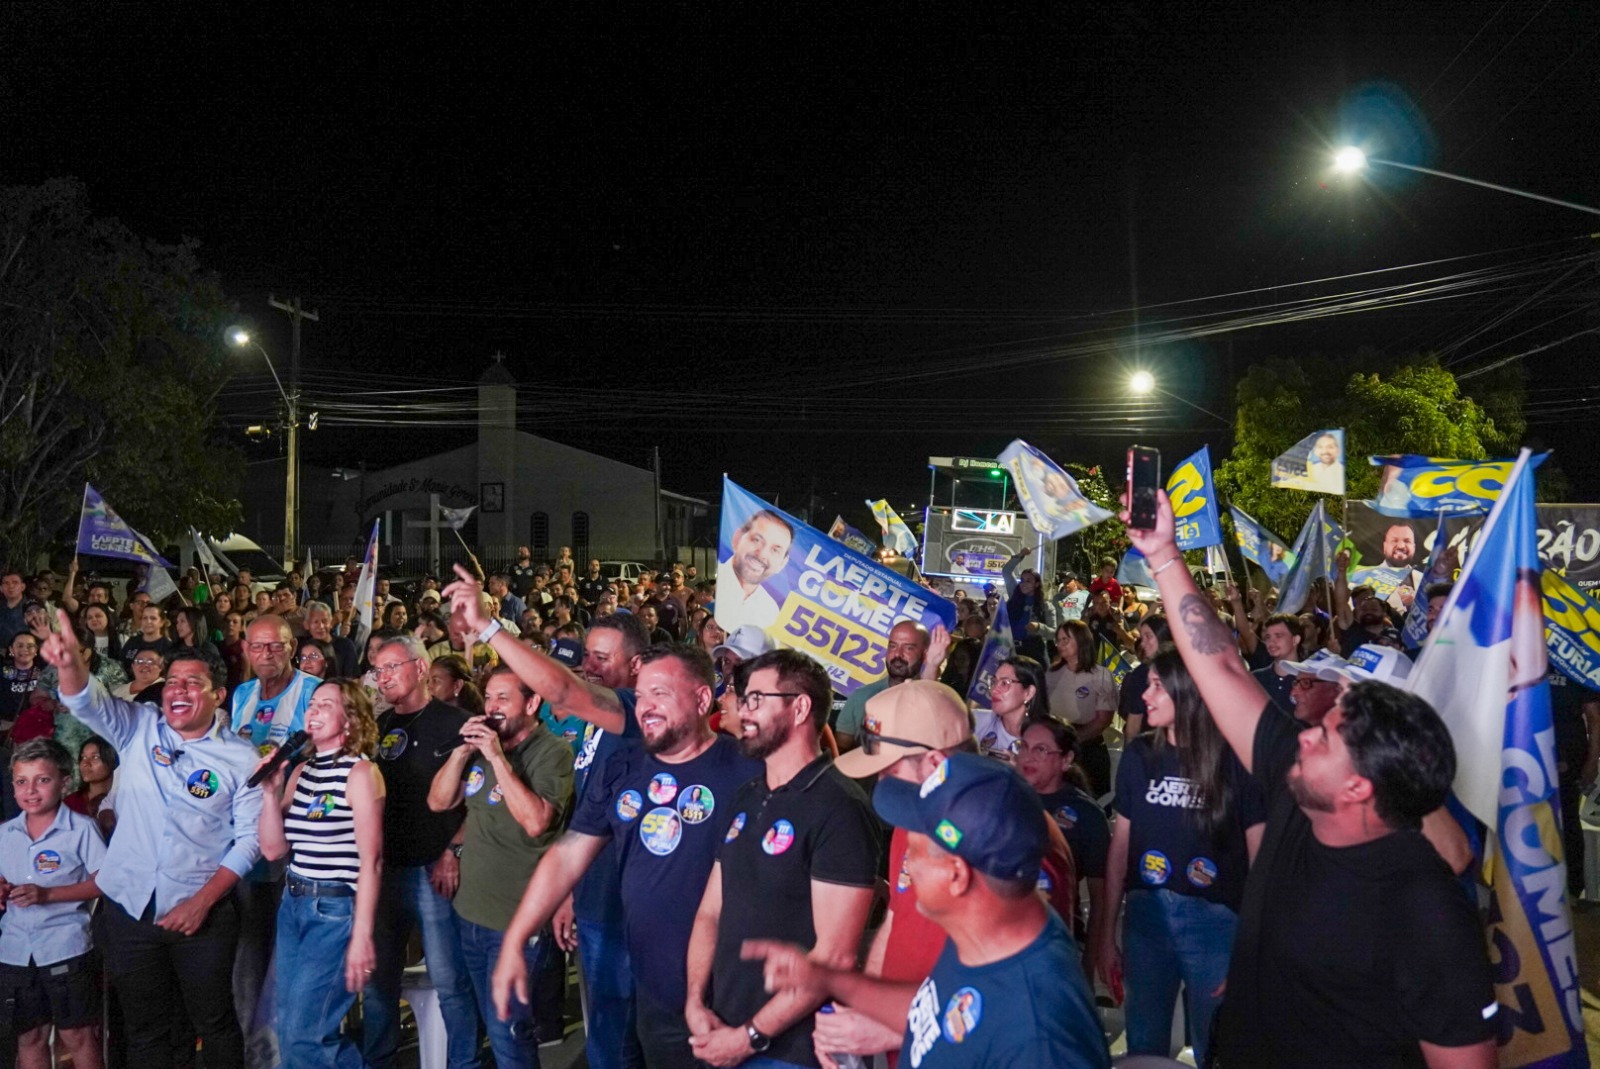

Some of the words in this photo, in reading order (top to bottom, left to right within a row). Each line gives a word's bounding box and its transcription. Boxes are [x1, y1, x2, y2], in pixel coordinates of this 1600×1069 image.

[843, 552, 874, 573] DEPUTADO
[873, 568, 902, 588] ESTADUAL
[804, 543, 928, 620] LAERTE
[784, 604, 887, 676] 55123
[190, 786, 209, 798] 5511
[641, 813, 670, 835] 55
[682, 808, 704, 820] 5511
[1144, 854, 1167, 872] 55
